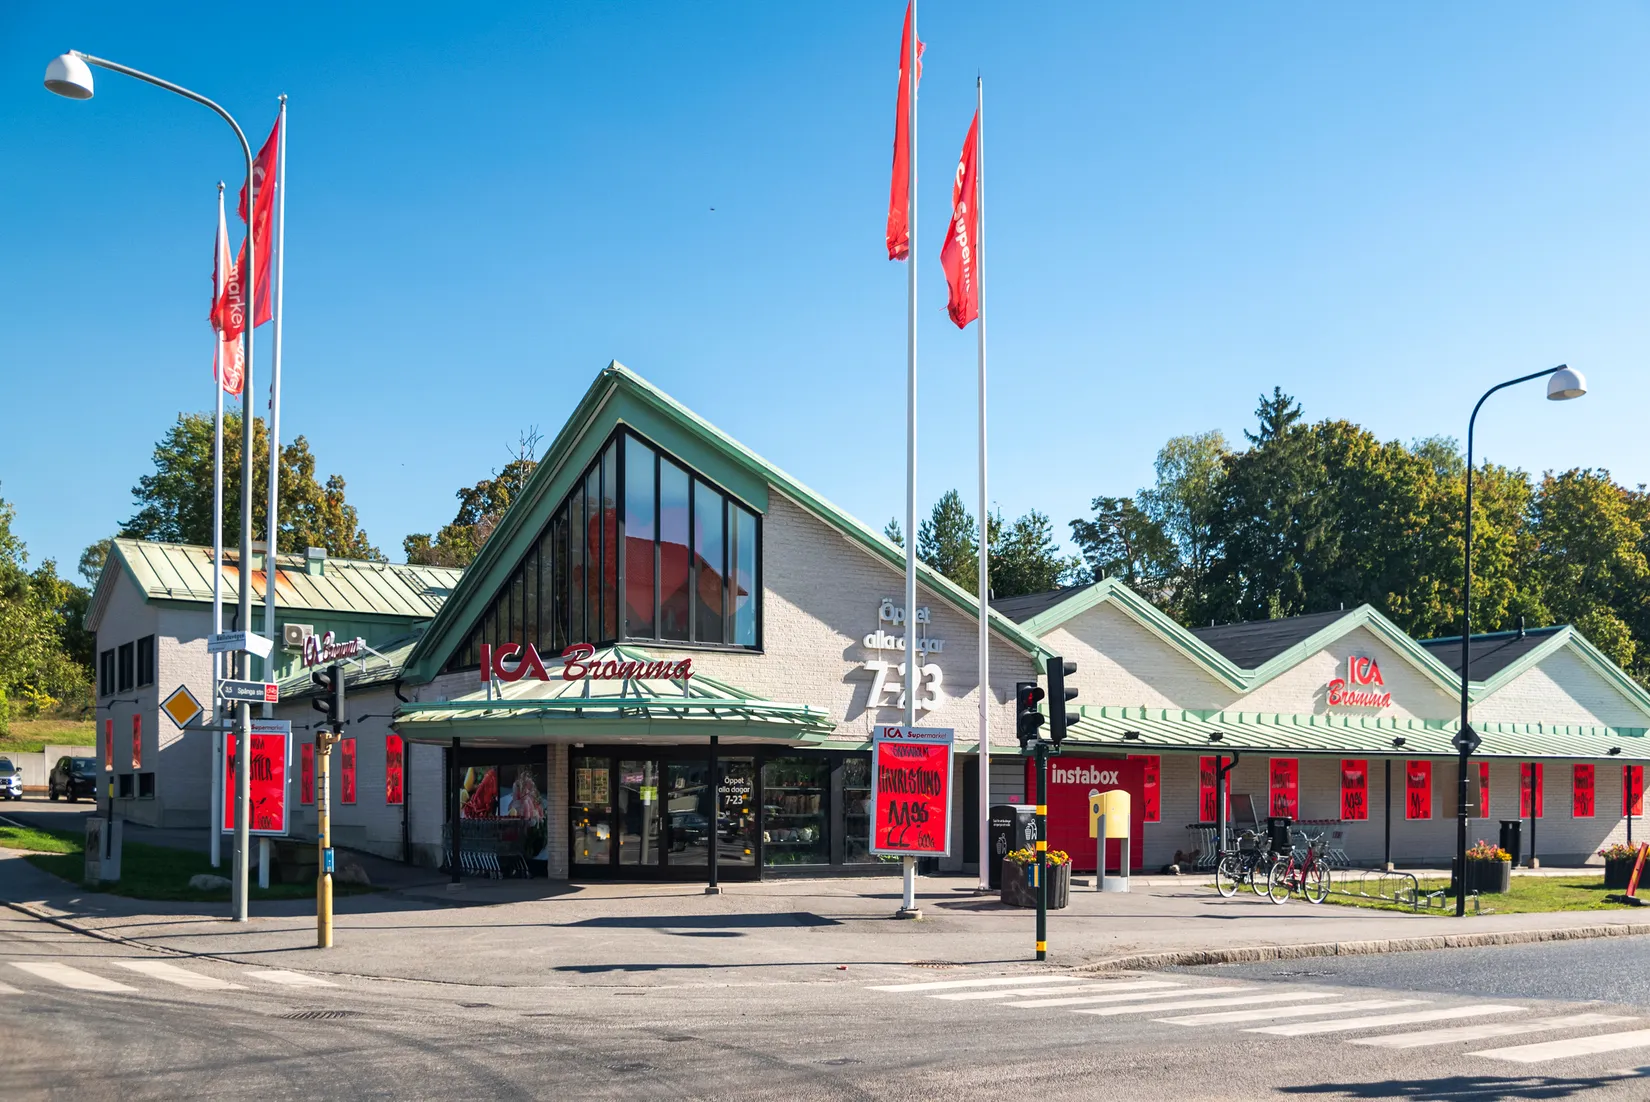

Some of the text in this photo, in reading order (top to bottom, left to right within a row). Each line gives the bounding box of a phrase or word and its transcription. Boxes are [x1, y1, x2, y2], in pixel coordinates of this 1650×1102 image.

[880, 598, 930, 626] Öpet
[480, 643, 695, 682] ICA Bromma
[1348, 656, 1384, 686] ICA
[1327, 677, 1391, 708] Bromma
[883, 727, 946, 739] ICA Supermarket
[724, 776, 744, 786] Öppet
[1052, 763, 1119, 785] instabox
[725, 795, 743, 805] 7-23
[731, 786, 750, 795] dagar
